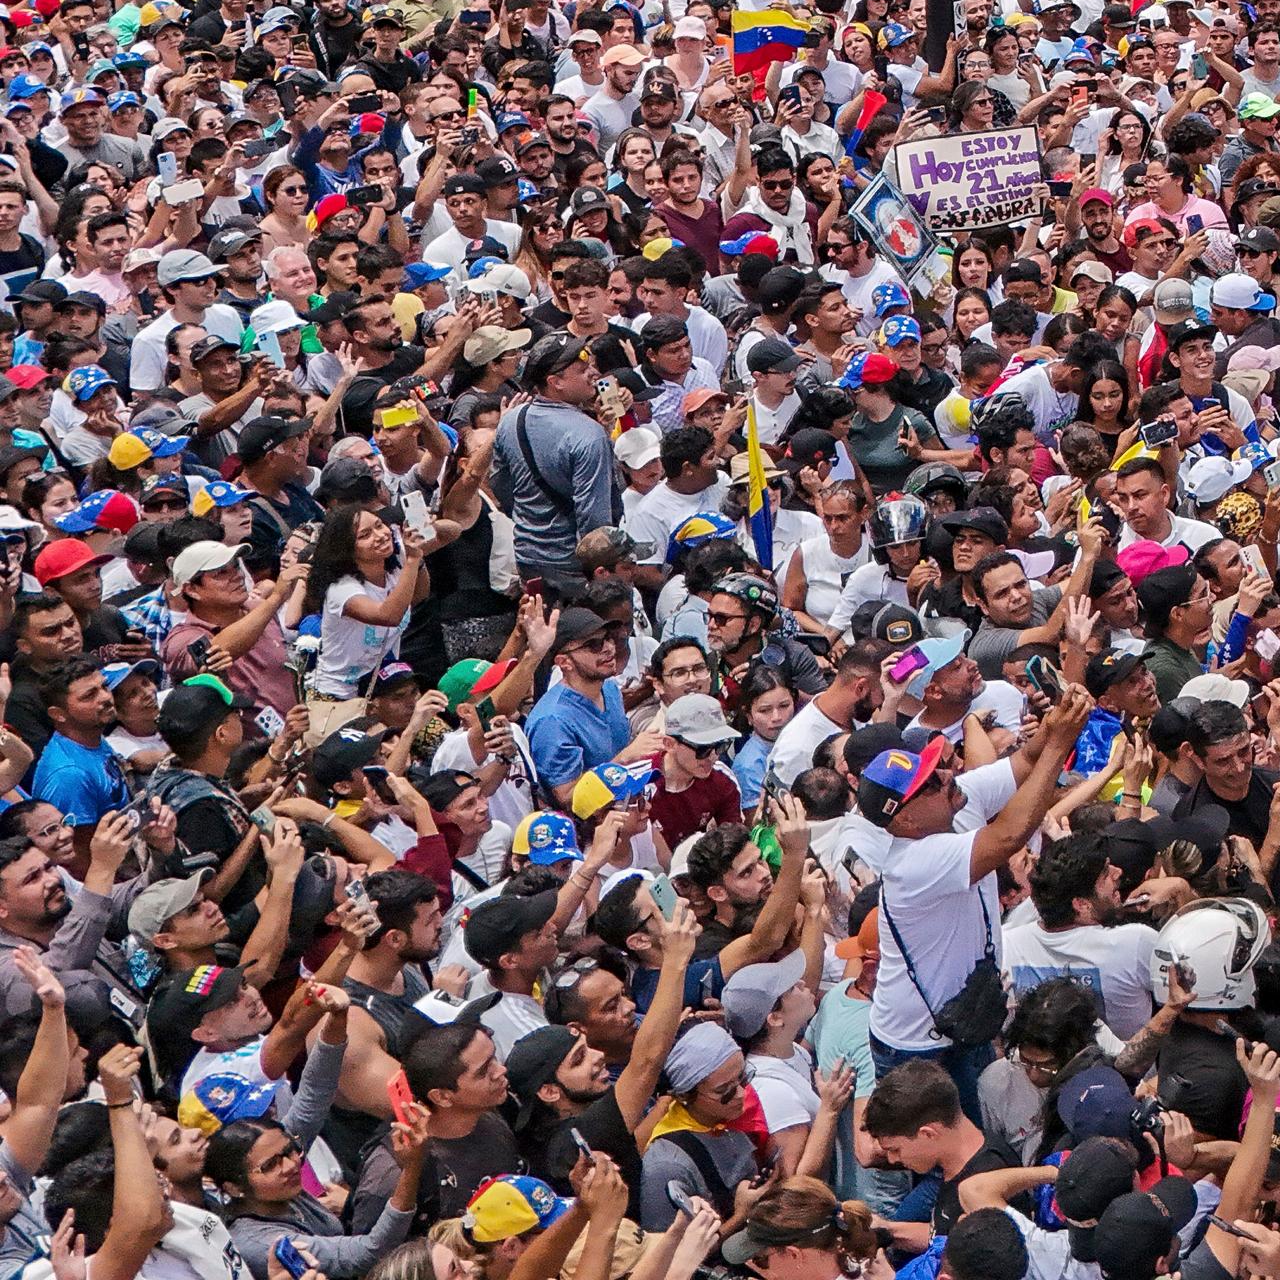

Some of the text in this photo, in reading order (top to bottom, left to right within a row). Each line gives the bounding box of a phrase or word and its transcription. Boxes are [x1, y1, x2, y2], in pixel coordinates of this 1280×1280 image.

[962, 135, 1022, 157] ESTOY
[967, 169, 1004, 195] 21
[936, 196, 962, 212] ES
[966, 194, 985, 208] EL
